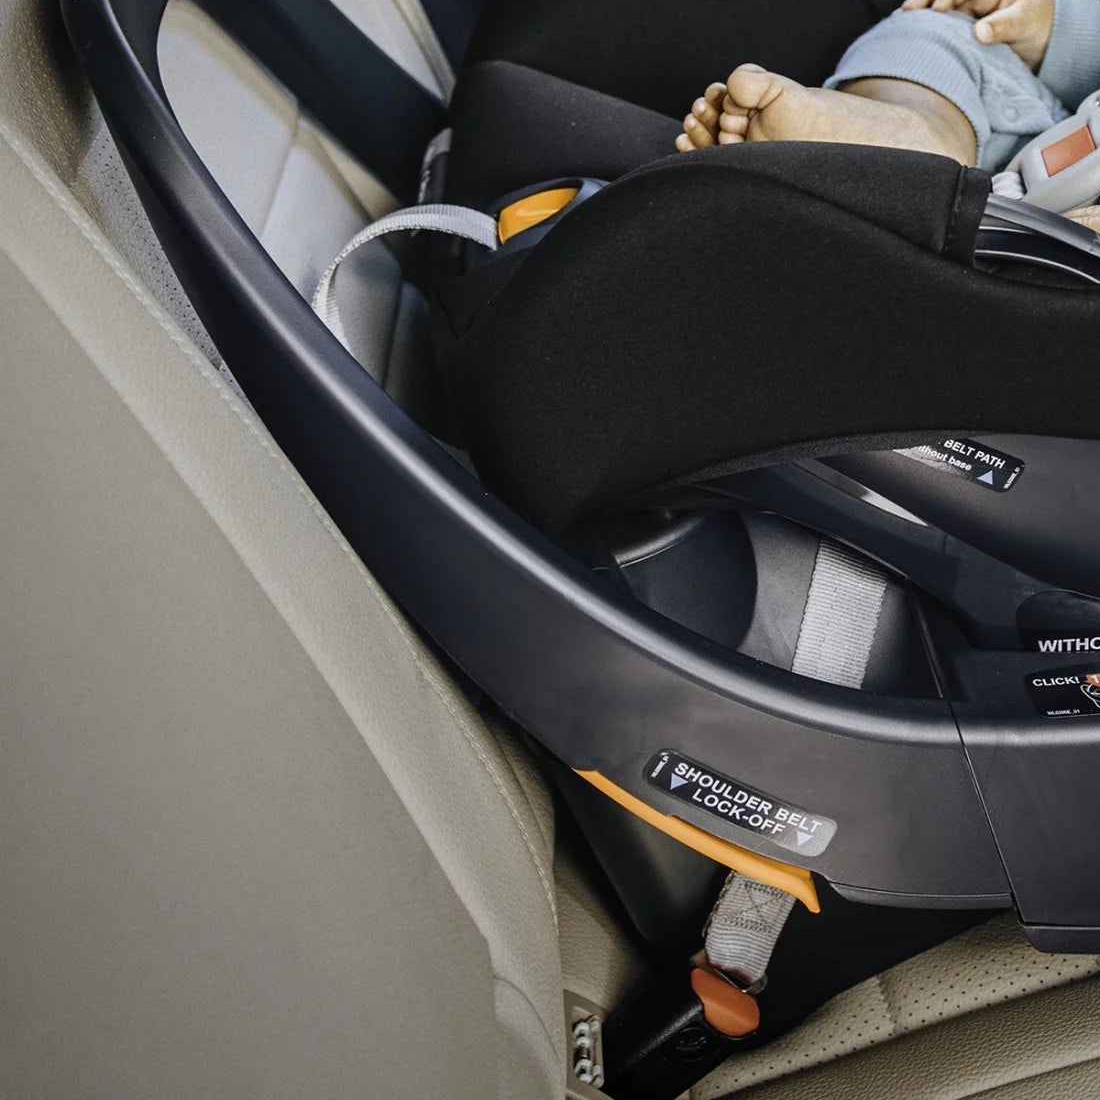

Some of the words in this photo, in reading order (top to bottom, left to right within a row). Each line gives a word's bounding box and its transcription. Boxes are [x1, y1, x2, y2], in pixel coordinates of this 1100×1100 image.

[944, 440, 976, 456] BELT
[974, 450, 1006, 470] PATH
[948, 455, 972, 470] base
[1032, 676, 1080, 688] CLICK!
[674, 762, 773, 816] SHOULDER
[774, 808, 822, 834] BELT
[692, 788, 786, 835] LOCK-OFF
